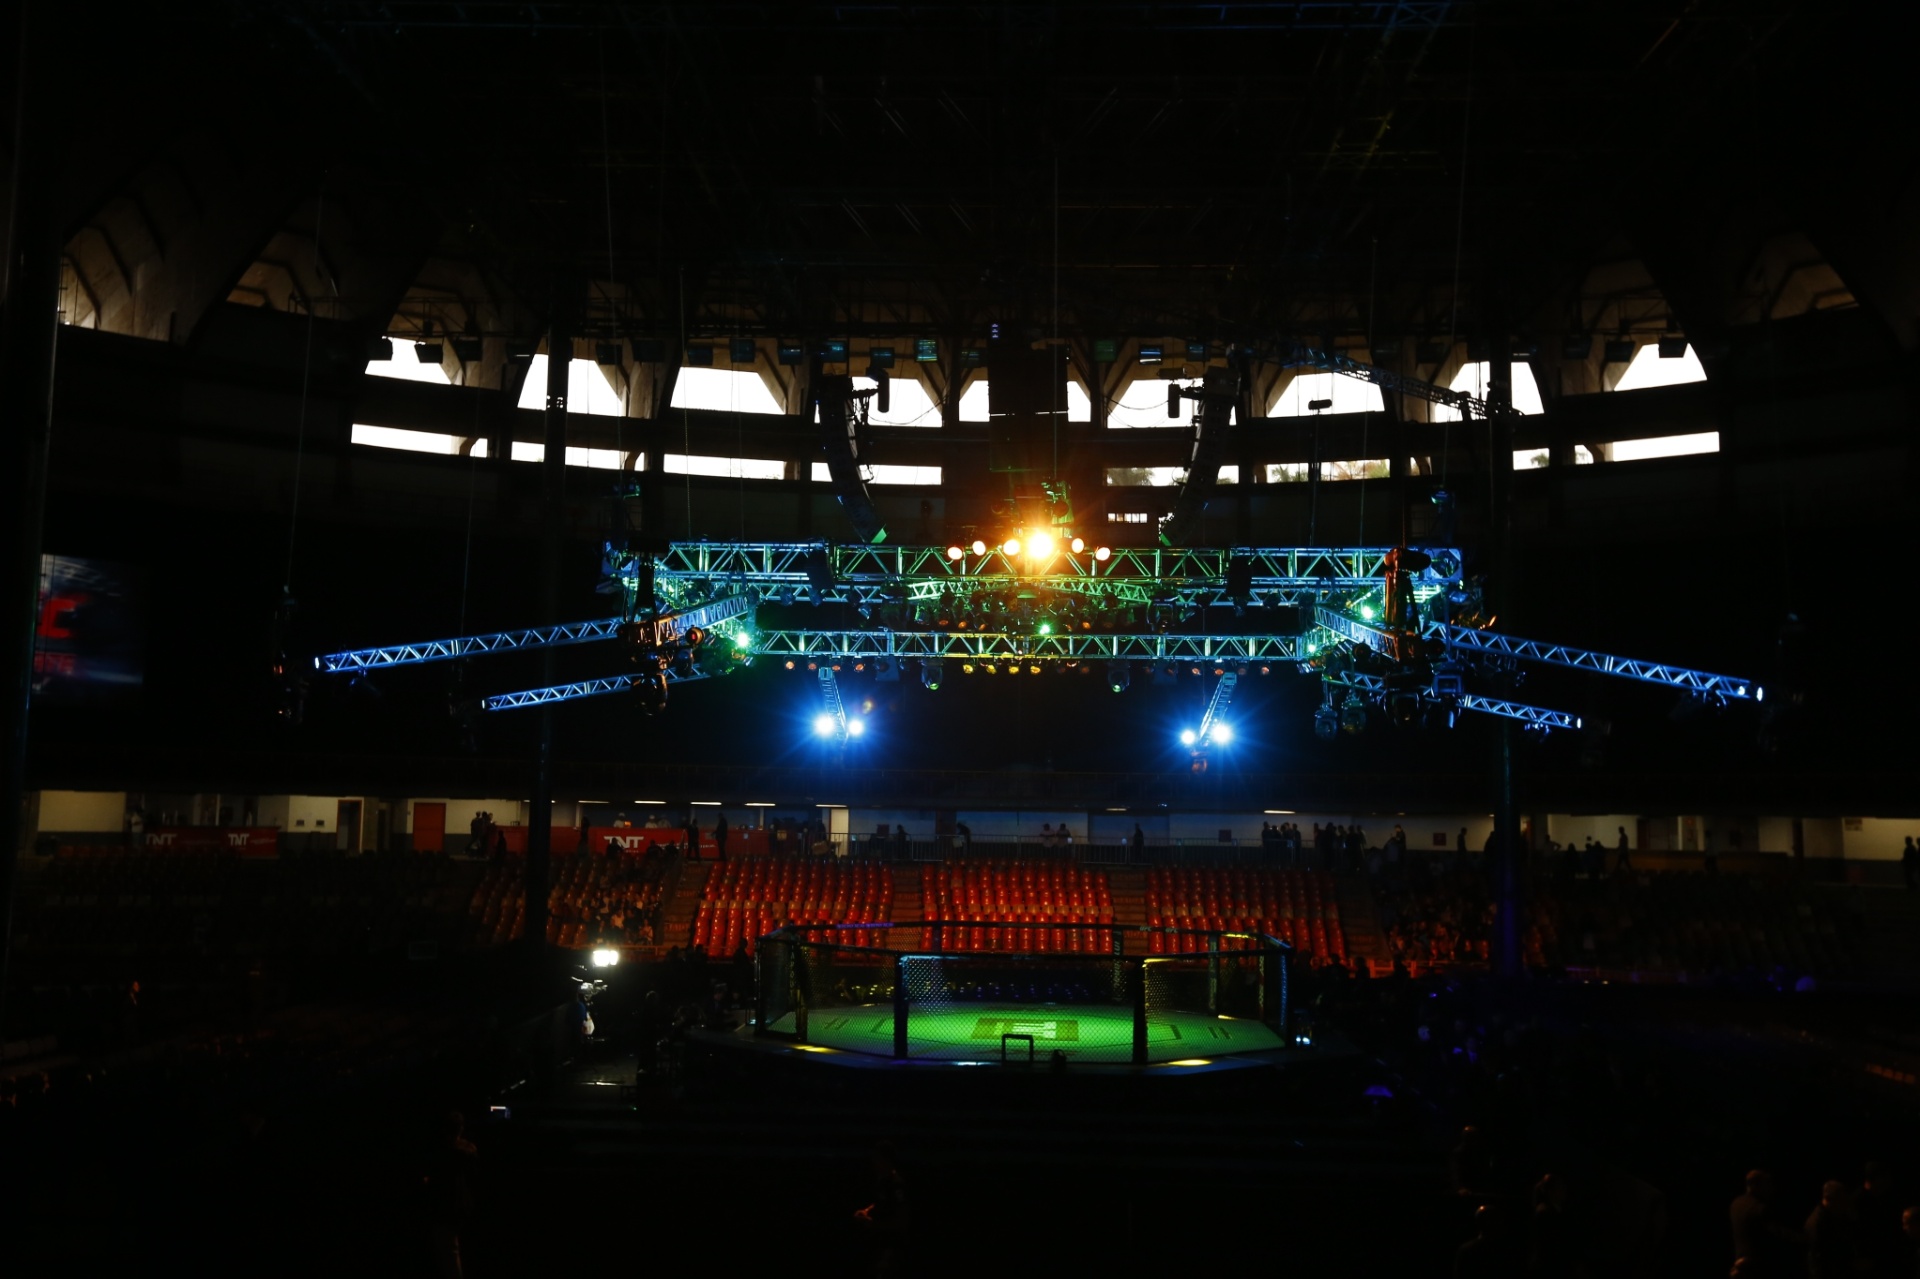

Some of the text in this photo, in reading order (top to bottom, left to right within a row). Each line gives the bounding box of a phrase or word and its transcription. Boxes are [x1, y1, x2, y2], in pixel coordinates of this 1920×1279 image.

[145, 832, 178, 846] TNT
[227, 832, 250, 846] TNT
[603, 835, 644, 849] TNT
